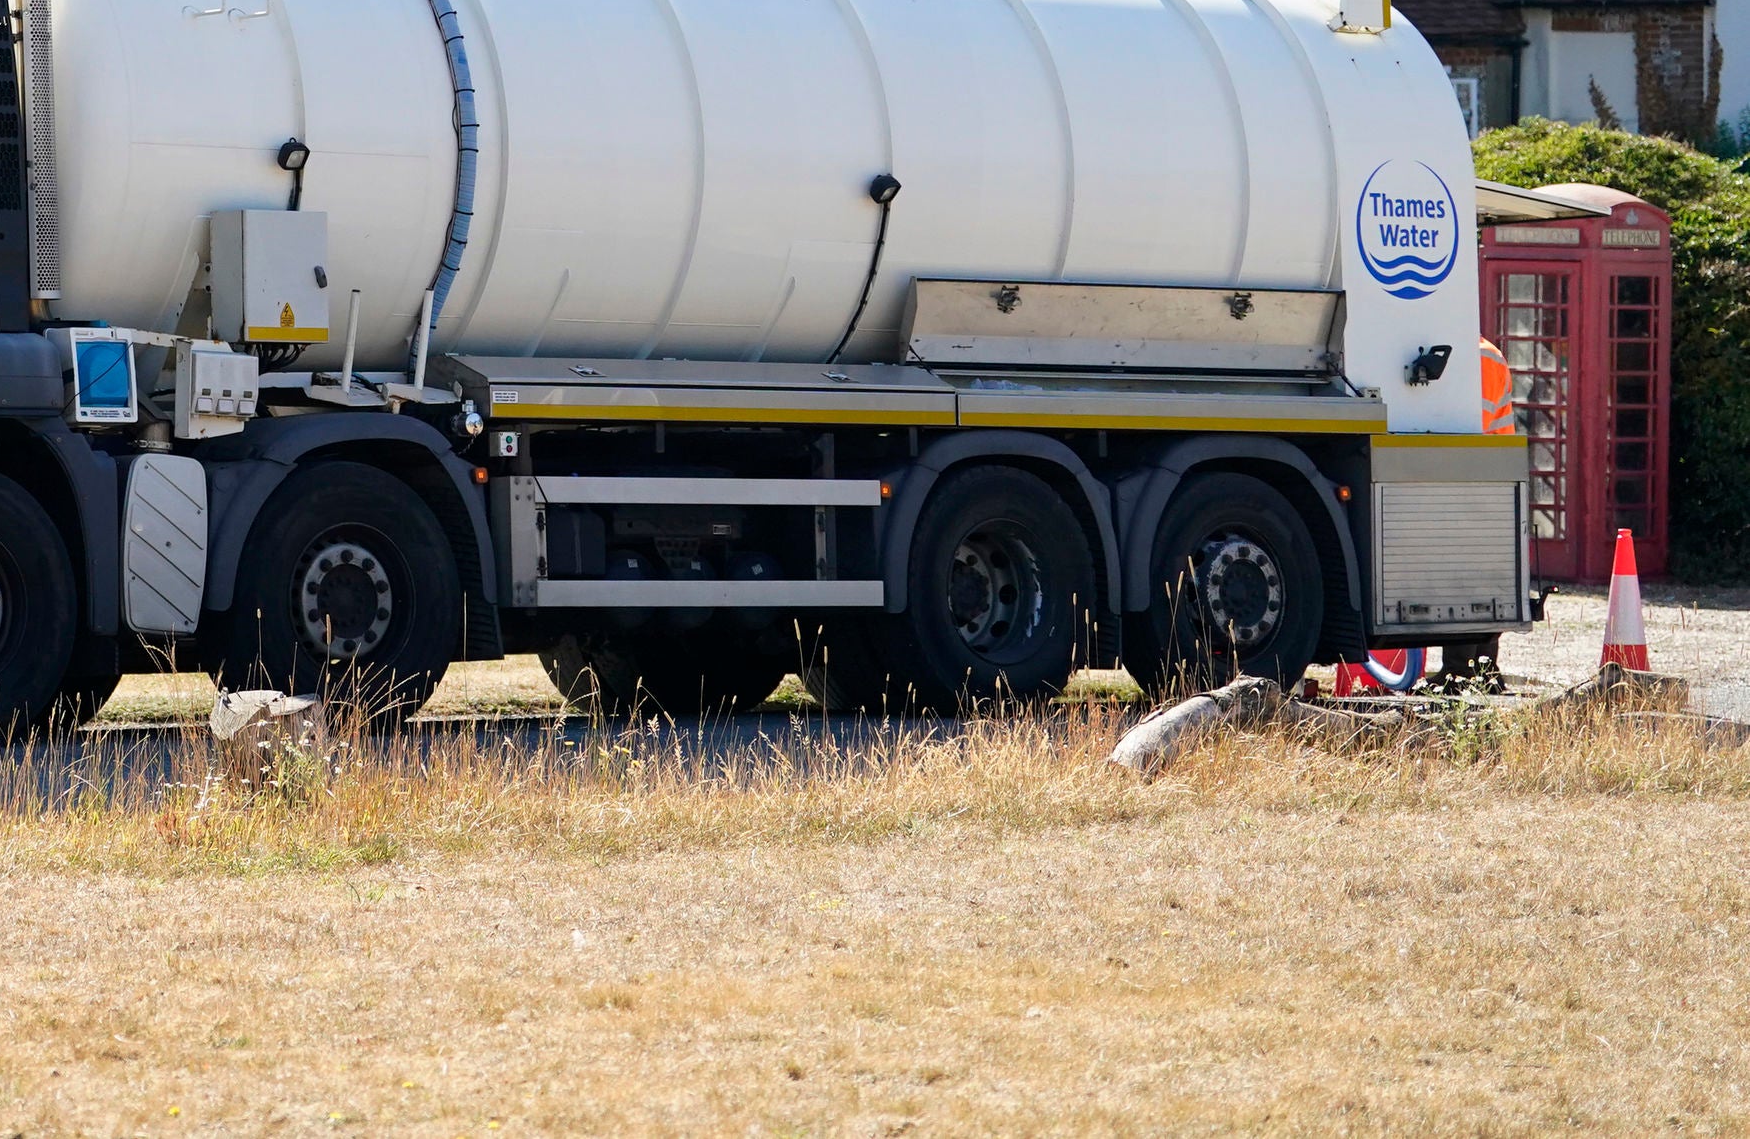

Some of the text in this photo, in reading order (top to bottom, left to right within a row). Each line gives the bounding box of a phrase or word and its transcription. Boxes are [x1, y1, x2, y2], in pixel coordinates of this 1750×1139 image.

[1369, 192, 1446, 219] Thames
[1379, 223, 1439, 248] Water
[1604, 230, 1658, 245] TELEPHONE
